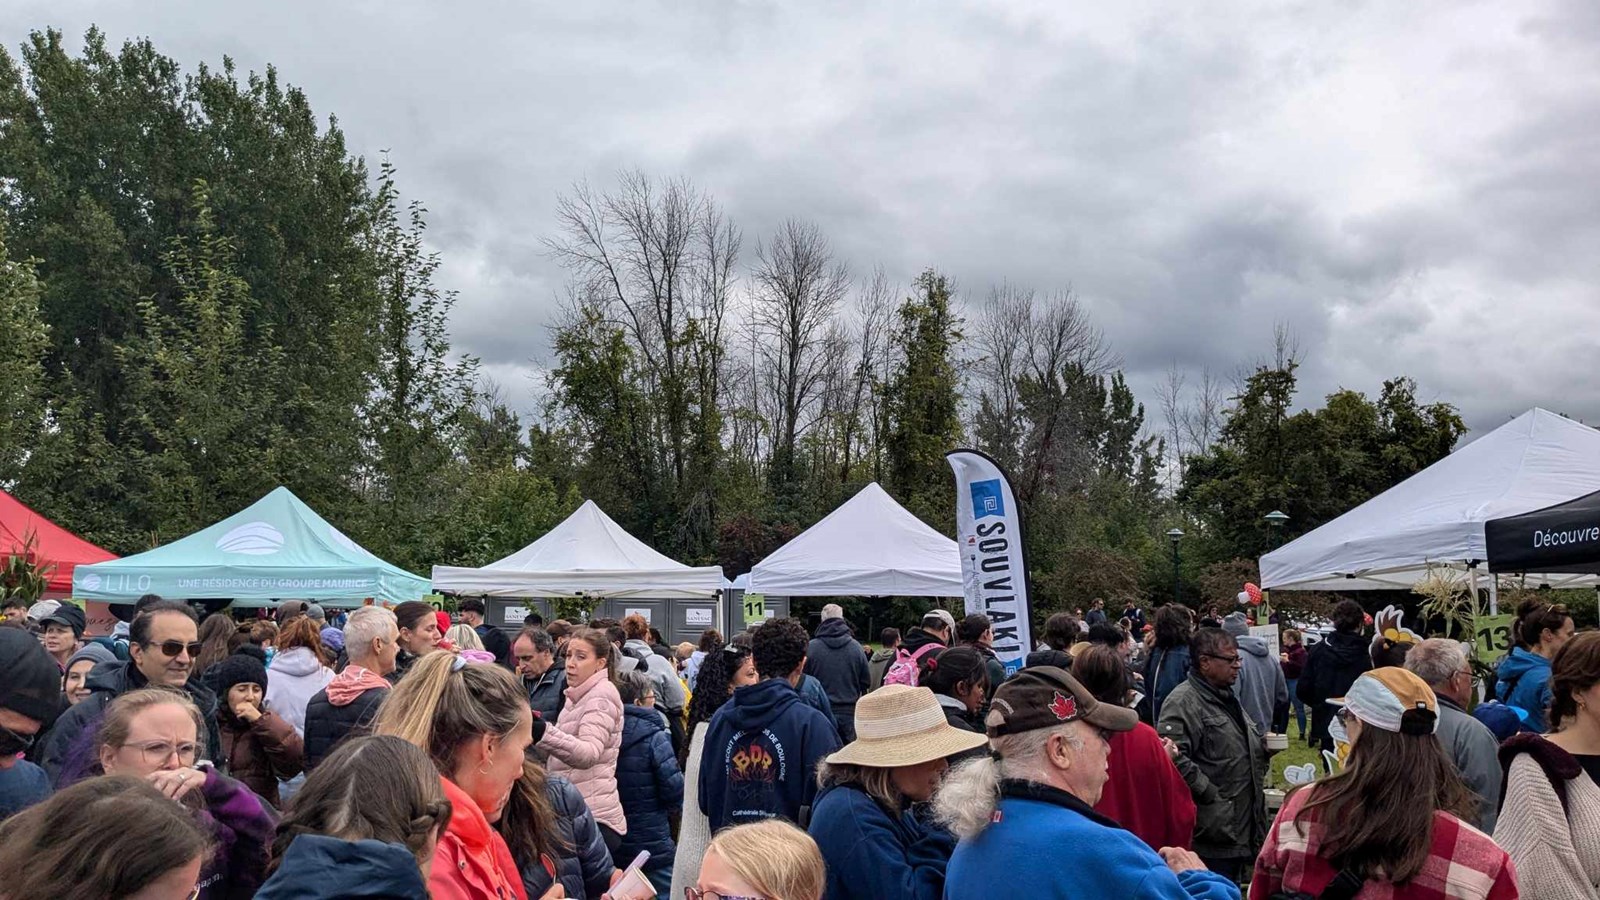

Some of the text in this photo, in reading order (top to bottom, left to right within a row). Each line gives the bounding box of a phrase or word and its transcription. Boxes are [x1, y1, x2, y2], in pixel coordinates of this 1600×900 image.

[105, 574, 151, 592] LILO
[178, 577, 368, 588] UNE RÉSIDENCE DU GROUPE MAURICE
[976, 522, 1020, 653] SOUVLAKI
[745, 601, 763, 616] 11
[1477, 626, 1511, 651] 13
[725, 739, 734, 763] SCOUT
[768, 733, 779, 744] DE
